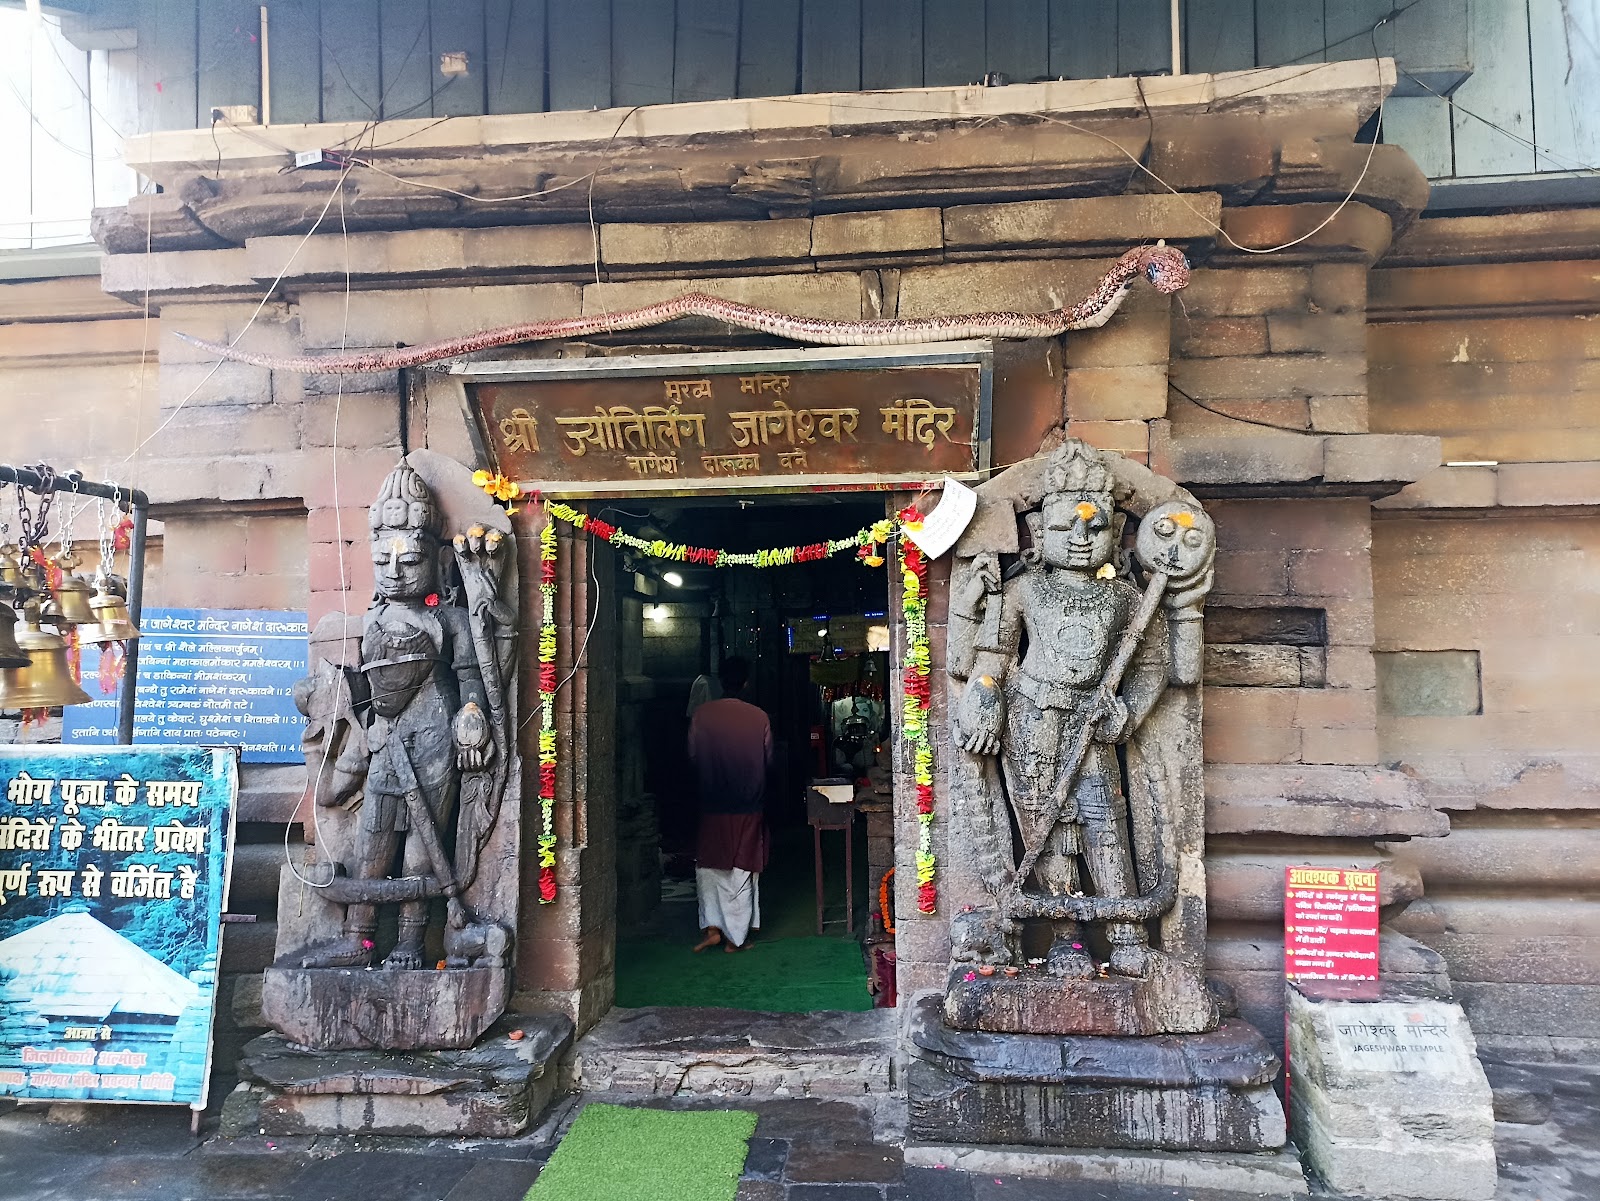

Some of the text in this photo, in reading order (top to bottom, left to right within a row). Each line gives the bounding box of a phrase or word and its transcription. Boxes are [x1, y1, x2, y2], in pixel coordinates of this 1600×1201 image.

[739, 373, 790, 396] मन्दिर
[500, 399, 956, 456] श्री ज्योतिर्लिंग जागेश्वर मंदिर
[625, 451, 678, 474] नागेशं
[777, 448, 808, 469] वने
[151, 615, 195, 631] जागेश्वर
[197, 617, 229, 632] मन्दिर
[232, 618, 264, 632] नागेशं
[7, 770, 202, 816] भोग पूजा के समय
[60, 818, 86, 852] के
[93, 818, 148, 853] भीतर
[153, 819, 208, 854] प्रवेश
[0, 862, 199, 906] ूर्ण रूप से वर्जित है
[1289, 869, 1376, 891] आवश्यक सूचना
[100, 1024, 112, 1040] से
[1337, 1020, 1398, 1038] जागेश्वर
[23, 1047, 97, 1064] जिलाधिकारी
[1354, 1045, 1444, 1054] JAGESHWAR TEMPLE
